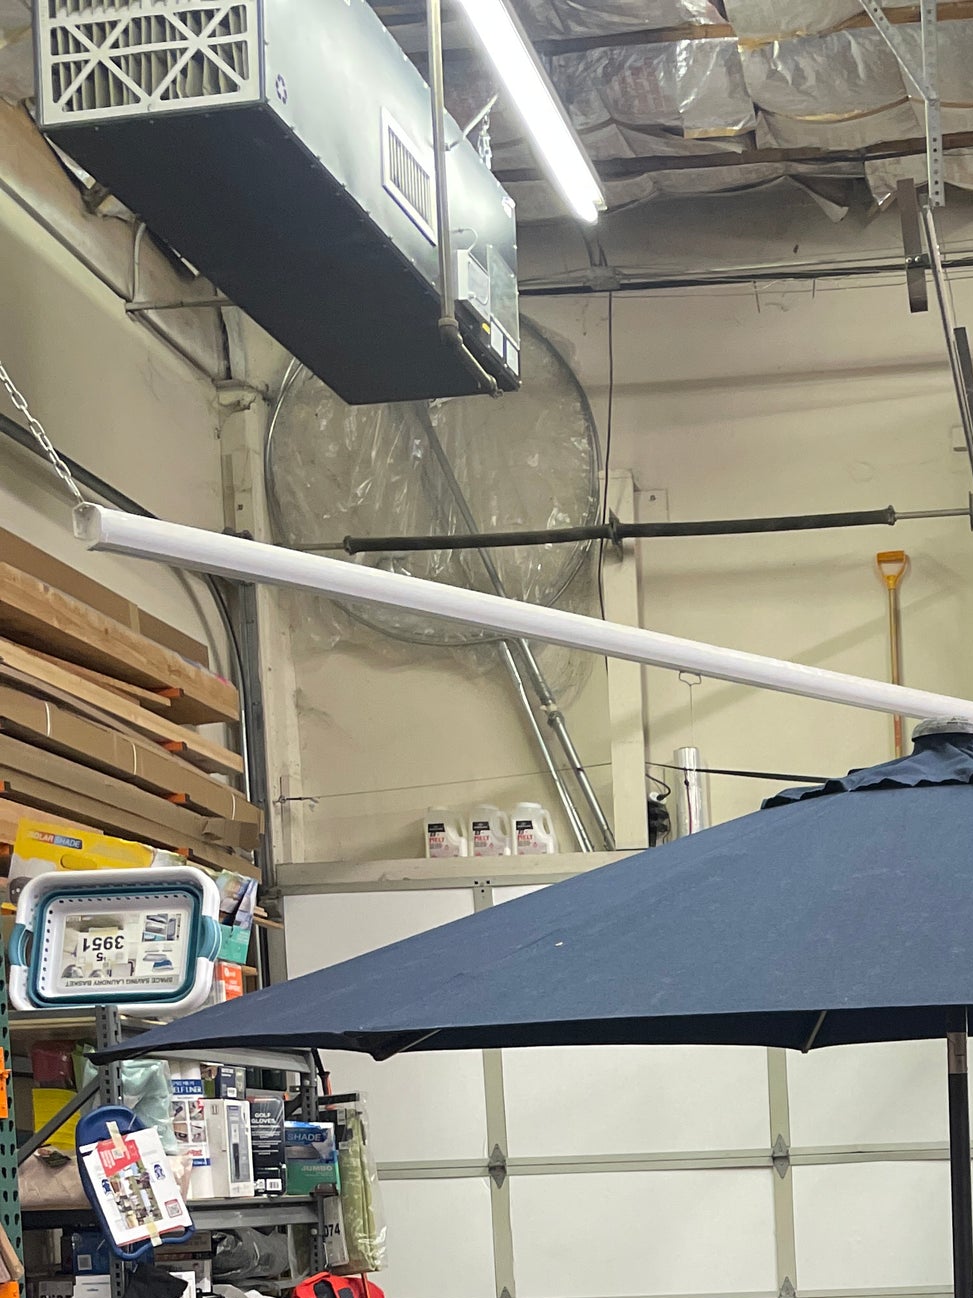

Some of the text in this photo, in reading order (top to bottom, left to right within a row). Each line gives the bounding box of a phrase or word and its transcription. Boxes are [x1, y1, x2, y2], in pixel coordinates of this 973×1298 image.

[82, 935, 125, 953] 3951
[65, 979, 92, 987] BASKET
[94, 978, 125, 986] LAUNDRY
